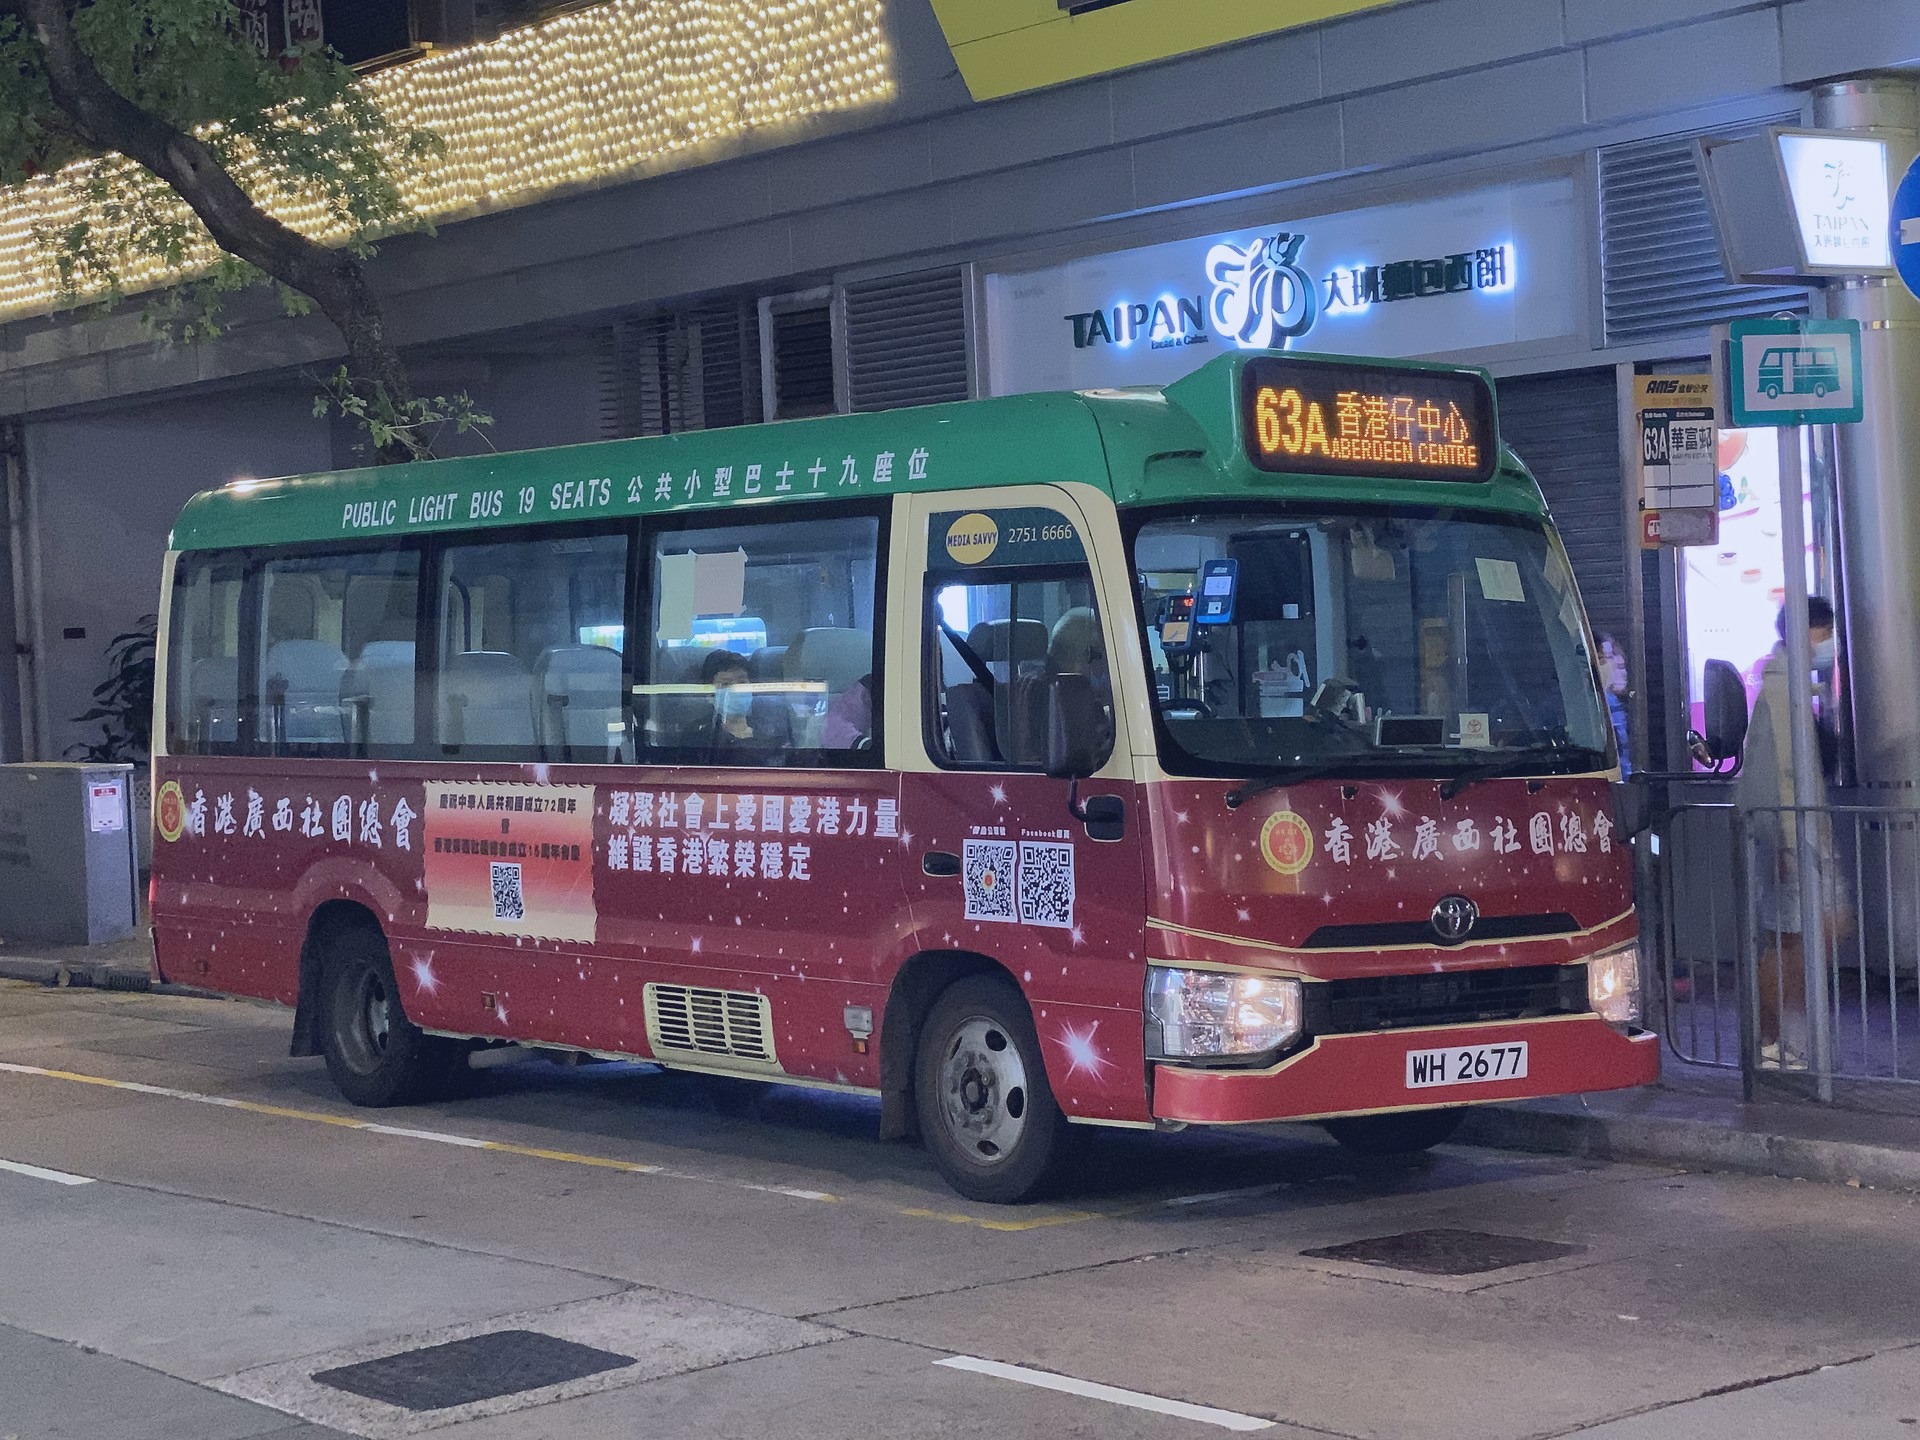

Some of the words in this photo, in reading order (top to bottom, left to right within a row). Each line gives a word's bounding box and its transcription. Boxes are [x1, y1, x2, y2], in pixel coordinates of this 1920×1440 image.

[1064, 295, 1205, 348] TAIPAN
[1646, 380, 1679, 394] AMS
[1257, 388, 1330, 454] 63A
[1336, 391, 1469, 443] 香港仔中心
[1331, 437, 1413, 462] ABERDEEN
[1418, 443, 1477, 466] CENTRE
[1644, 427, 1668, 460] 63A
[627, 447, 929, 503] 公共小型巴士十九座位
[342, 499, 397, 529] PUBLIC
[408, 493, 458, 524] LIGHT
[469, 489, 504, 519] BUS
[518, 486, 535, 514] 19
[550, 478, 612, 510] SEATS
[947, 533, 971, 547] MEDIA
[973, 532, 998, 545] SAVVY
[1008, 526, 1037, 543] 2751
[1041, 524, 1073, 541] 6666
[608, 790, 899, 838] 凝聚社會上愛國愛港力量
[607, 834, 812, 880] 維護香港繁榮穩定
[1412, 1054, 1446, 1083] WH
[1457, 1047, 1522, 1080] 2677
